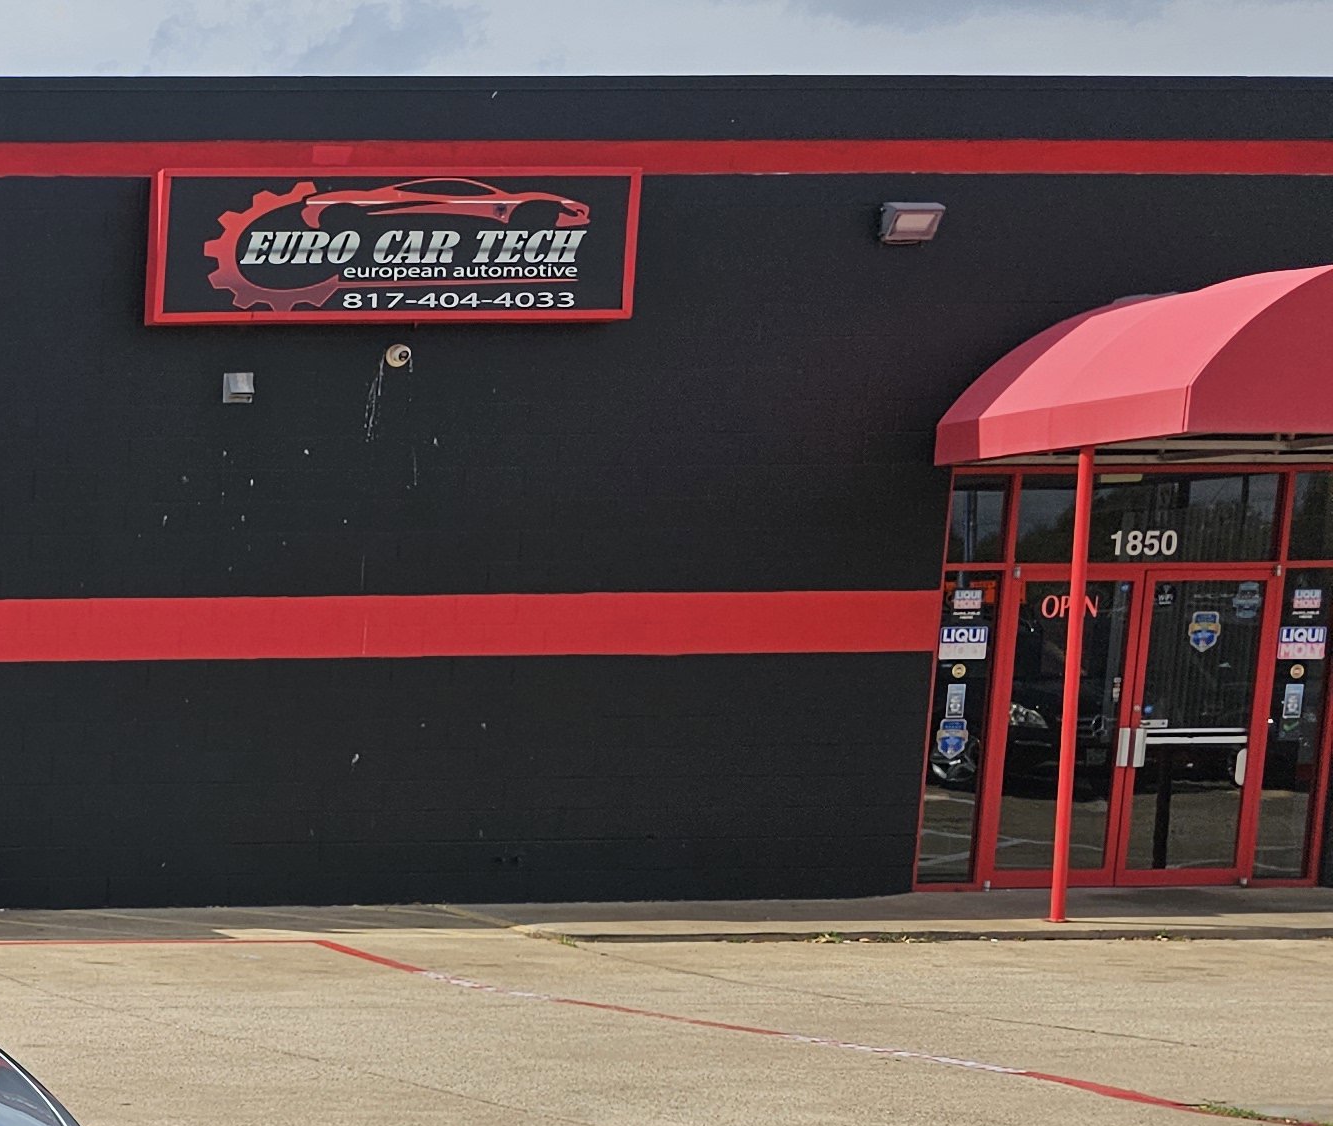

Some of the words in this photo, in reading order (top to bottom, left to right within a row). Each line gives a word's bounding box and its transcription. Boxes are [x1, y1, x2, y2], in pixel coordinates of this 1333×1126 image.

[239, 230, 361, 264] EURO
[373, 230, 460, 264] CAR
[472, 230, 587, 263] TECH
[343, 266, 447, 281] european
[452, 263, 578, 278] automotive
[342, 291, 575, 309] 817-404-4033
[1110, 530, 1178, 556] 1850
[1041, 595, 1099, 619] OPN
[942, 628, 986, 643] LIQUI
[1281, 628, 1324, 643] LIQUI
